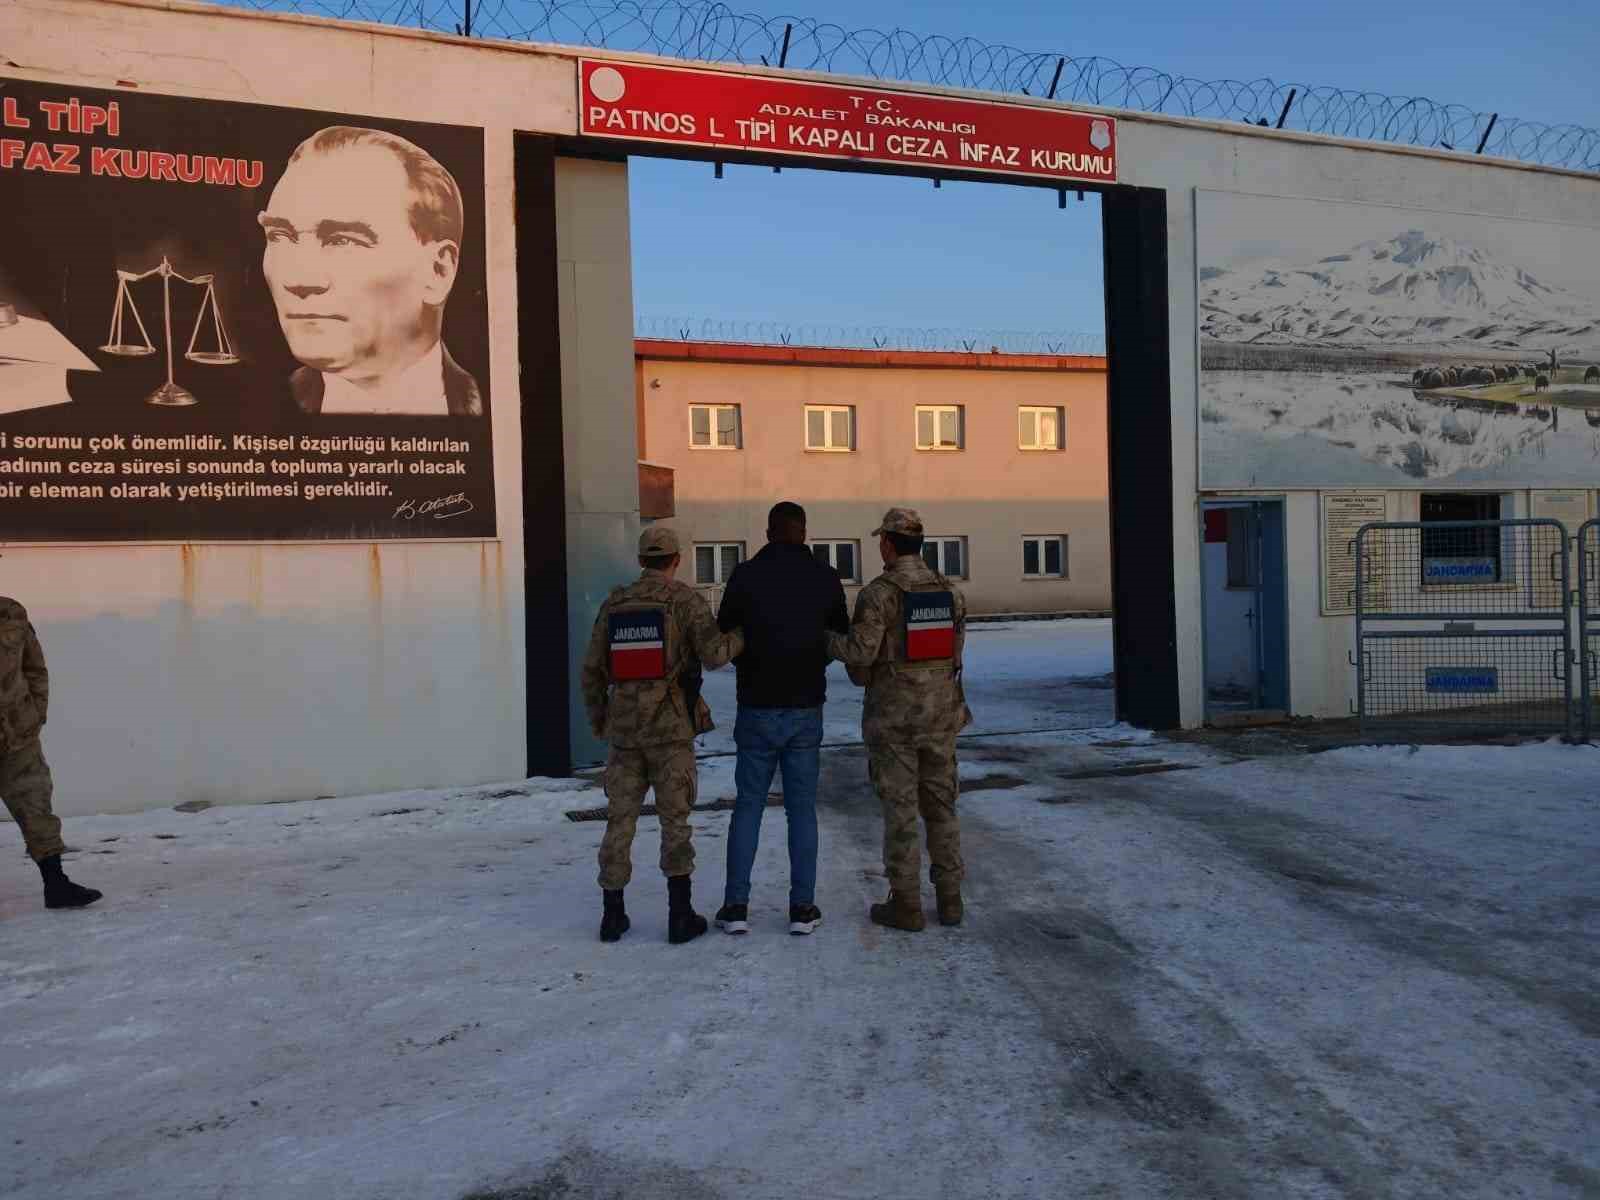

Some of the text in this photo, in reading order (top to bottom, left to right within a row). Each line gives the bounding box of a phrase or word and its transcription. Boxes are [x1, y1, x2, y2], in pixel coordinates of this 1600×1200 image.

[758, 103, 848, 121] ADALET
[850, 96, 900, 113] T.C.
[4, 97, 119, 136] L TİPİ
[589, 106, 1113, 175] PATNOS L TİPİ KAPALI CEZA İNFAZ KURUMU
[91, 147, 264, 189] KURUMU
[13, 436, 82, 449] sorunu
[89, 435, 125, 453] çok
[132, 435, 227, 451] önemlidir.
[233, 435, 294, 454] Kişisel
[300, 436, 385, 454] özgürlüğü
[391, 437, 470, 453] kaldırılan
[68, 460, 116, 474] ceza
[121, 459, 181, 474] süresi
[187, 460, 265, 474] sonunda
[271, 460, 343, 477] topluma
[350, 460, 403, 477] yararlı
[409, 460, 466, 474] olacak
[29, 482, 103, 498] eleman
[110, 482, 172, 498] olarak
[178, 482, 298, 501] yetiştirilmesi
[304, 482, 393, 500] gereklidir.
[613, 626, 659, 641] JANDARMA
